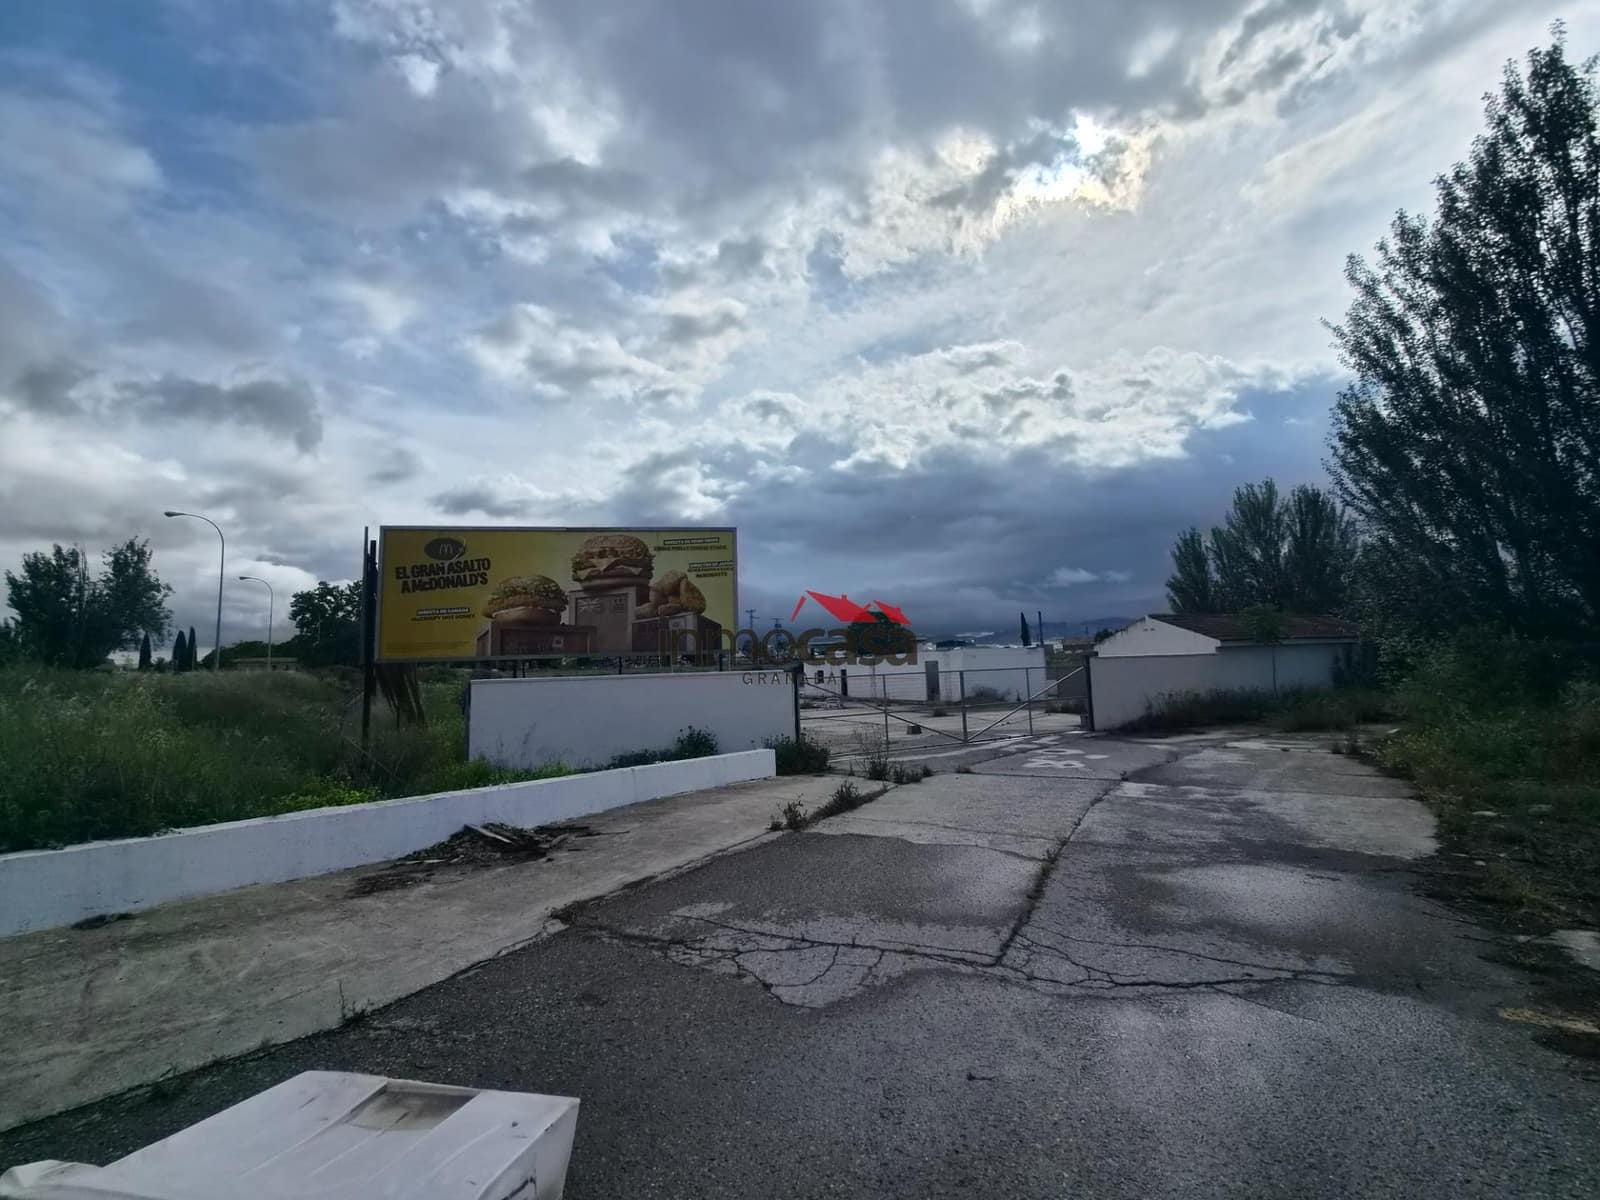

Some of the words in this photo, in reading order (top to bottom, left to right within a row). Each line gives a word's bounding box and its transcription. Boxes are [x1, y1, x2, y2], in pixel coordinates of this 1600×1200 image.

[395, 566, 409, 579] EL
[411, 562, 445, 577] GRAN
[447, 558, 491, 574] ASALTO
[401, 581, 411, 594] A
